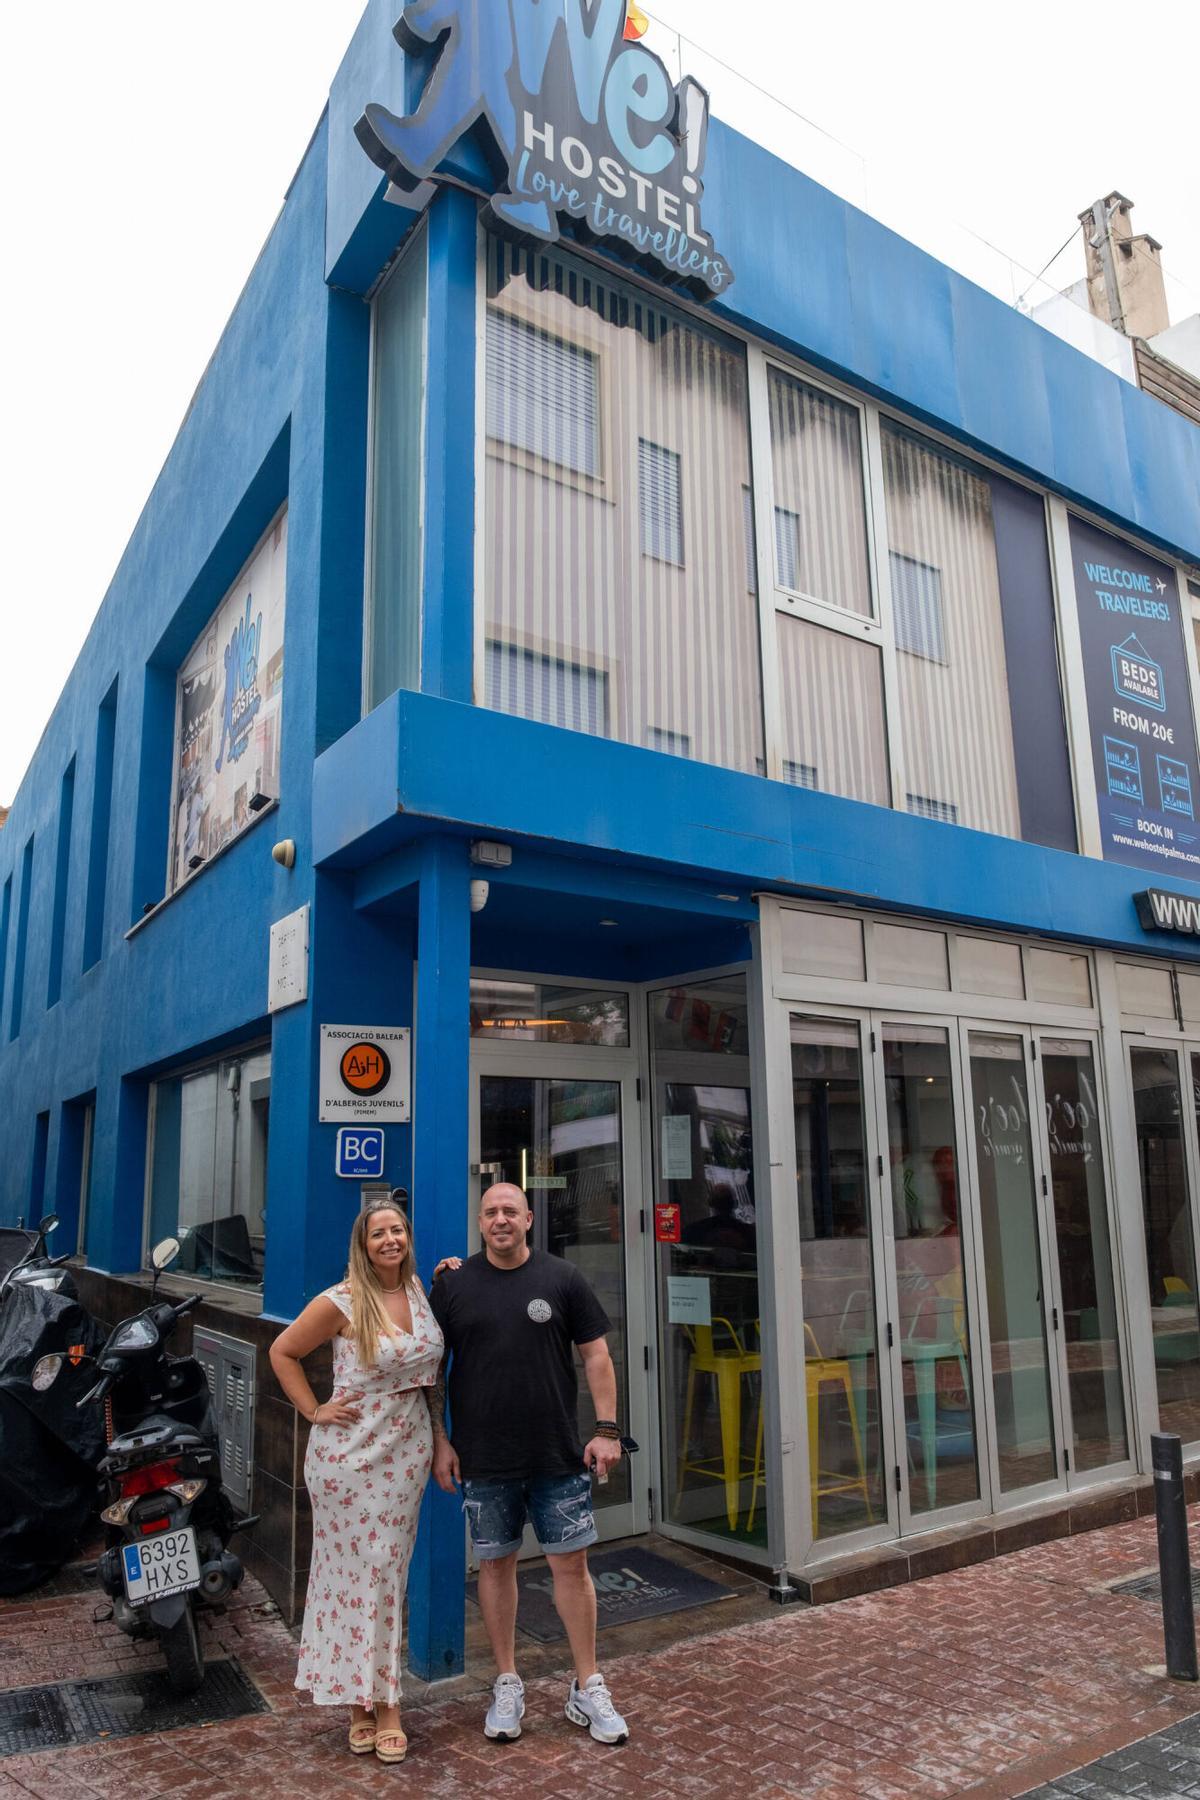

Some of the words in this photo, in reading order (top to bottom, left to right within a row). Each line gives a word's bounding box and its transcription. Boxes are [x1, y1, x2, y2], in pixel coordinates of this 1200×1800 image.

[524, 110, 708, 246] HOSTEL
[516, 151, 586, 210] Love
[591, 193, 729, 286] travellers
[1084, 562, 1153, 593] WELCOME
[1095, 590, 1171, 621] TRAVELERS!
[1121, 659, 1157, 687] BEDS
[1123, 678, 1159, 699] AVAILABLE
[232, 681, 258, 726] HOSTEL
[1113, 706, 1150, 735] FROM
[1151, 722, 1174, 744] 20€
[1137, 819, 1163, 836] BOOK
[1163, 827, 1174, 840] IN
[327, 1030, 374, 1040] ASSOCIACIÓ
[376, 1033, 404, 1041] BALEAR
[325, 1100, 367, 1108] D'ALBERGS
[369, 1100, 404, 1108] JUVENILS
[344, 1137, 378, 1162] BC
[140, 1533, 190, 1565] 6392
[130, 1566, 138, 1575] E
[145, 1559, 189, 1591] HXS
